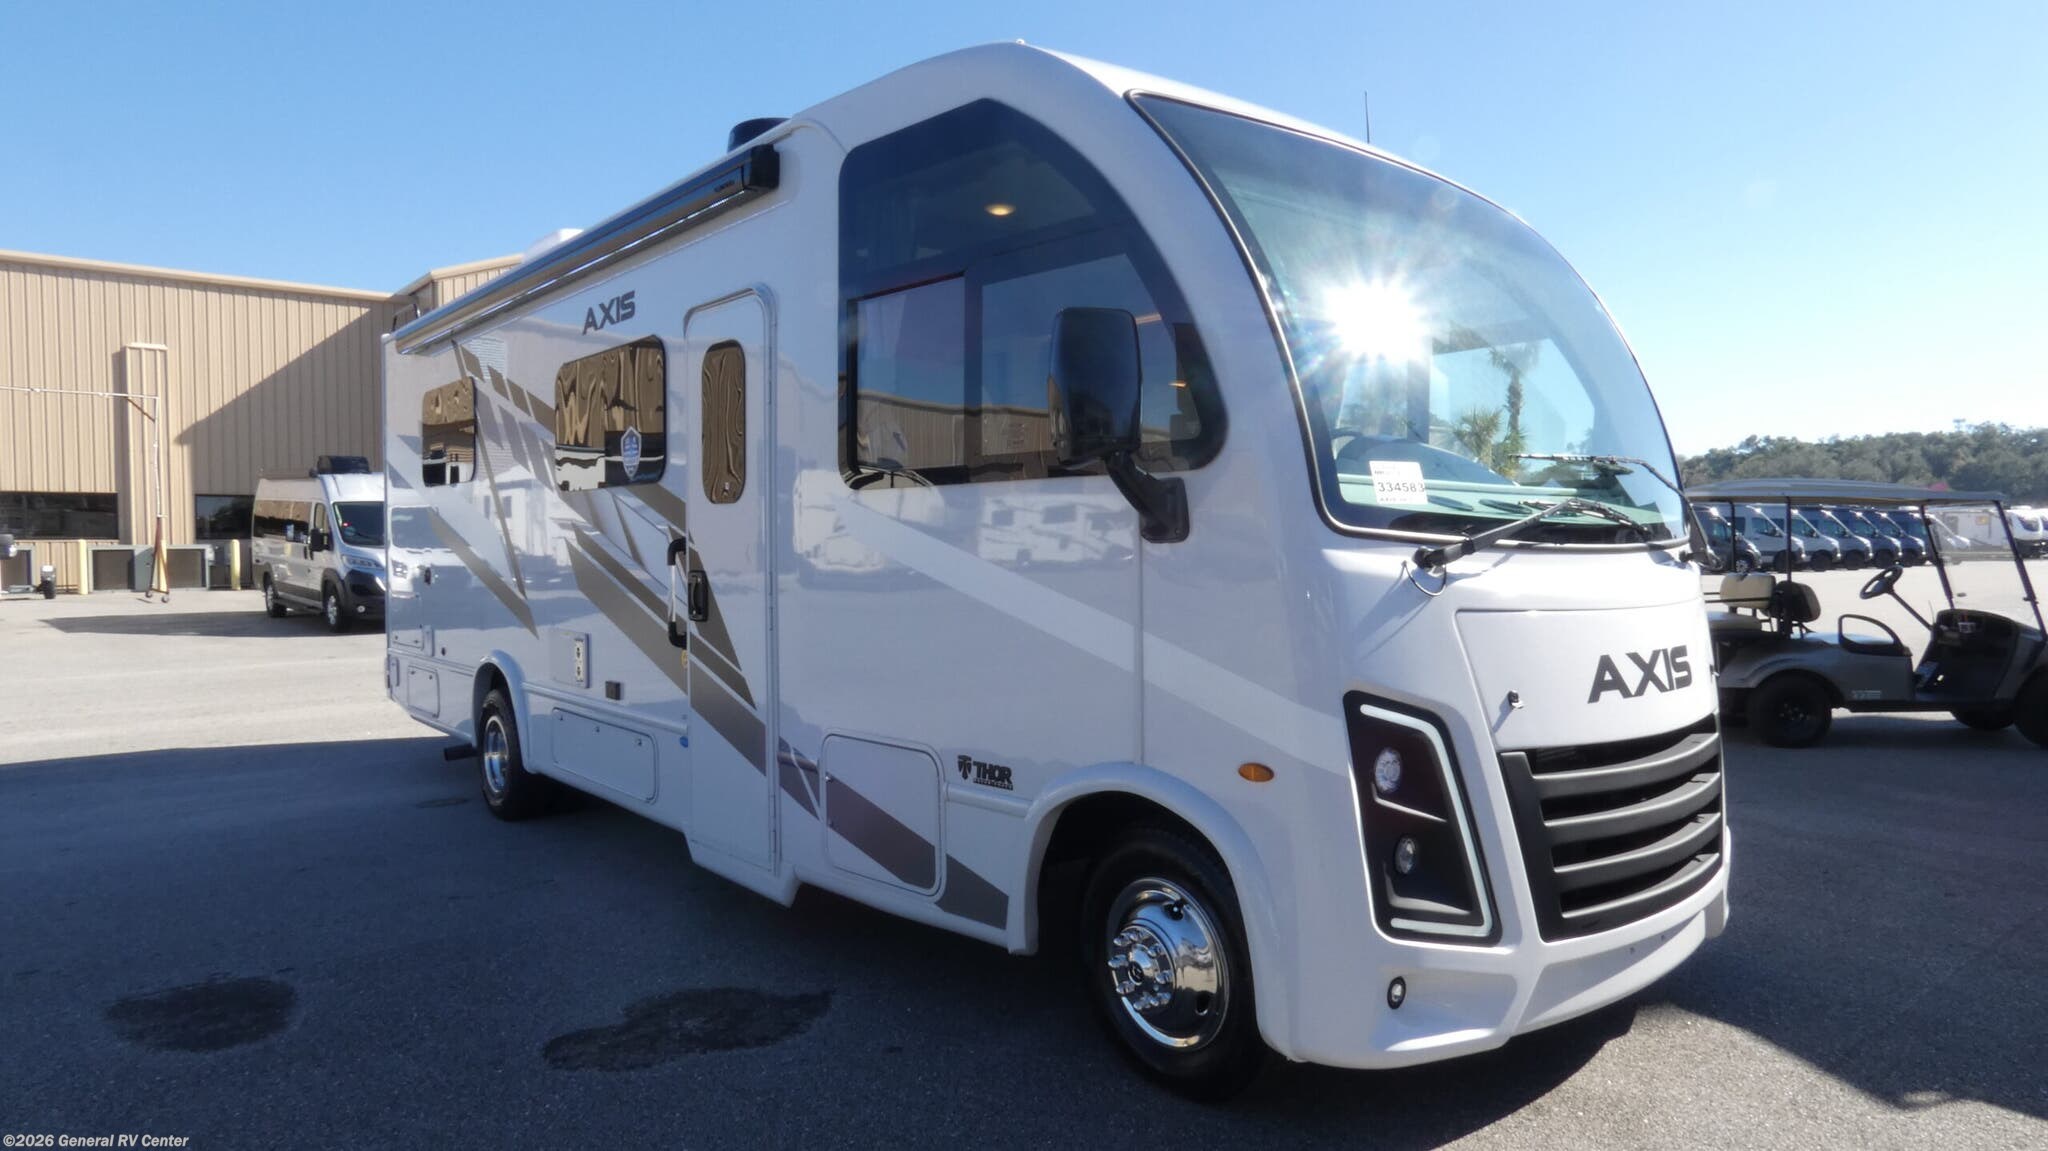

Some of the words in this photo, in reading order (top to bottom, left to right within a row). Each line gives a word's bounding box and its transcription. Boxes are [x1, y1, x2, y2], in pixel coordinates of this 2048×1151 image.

[582, 290, 636, 336] AXIS
[1377, 481, 1426, 493] 334583
[1587, 644, 1693, 704] AXIS
[973, 760, 1013, 785] THOR
